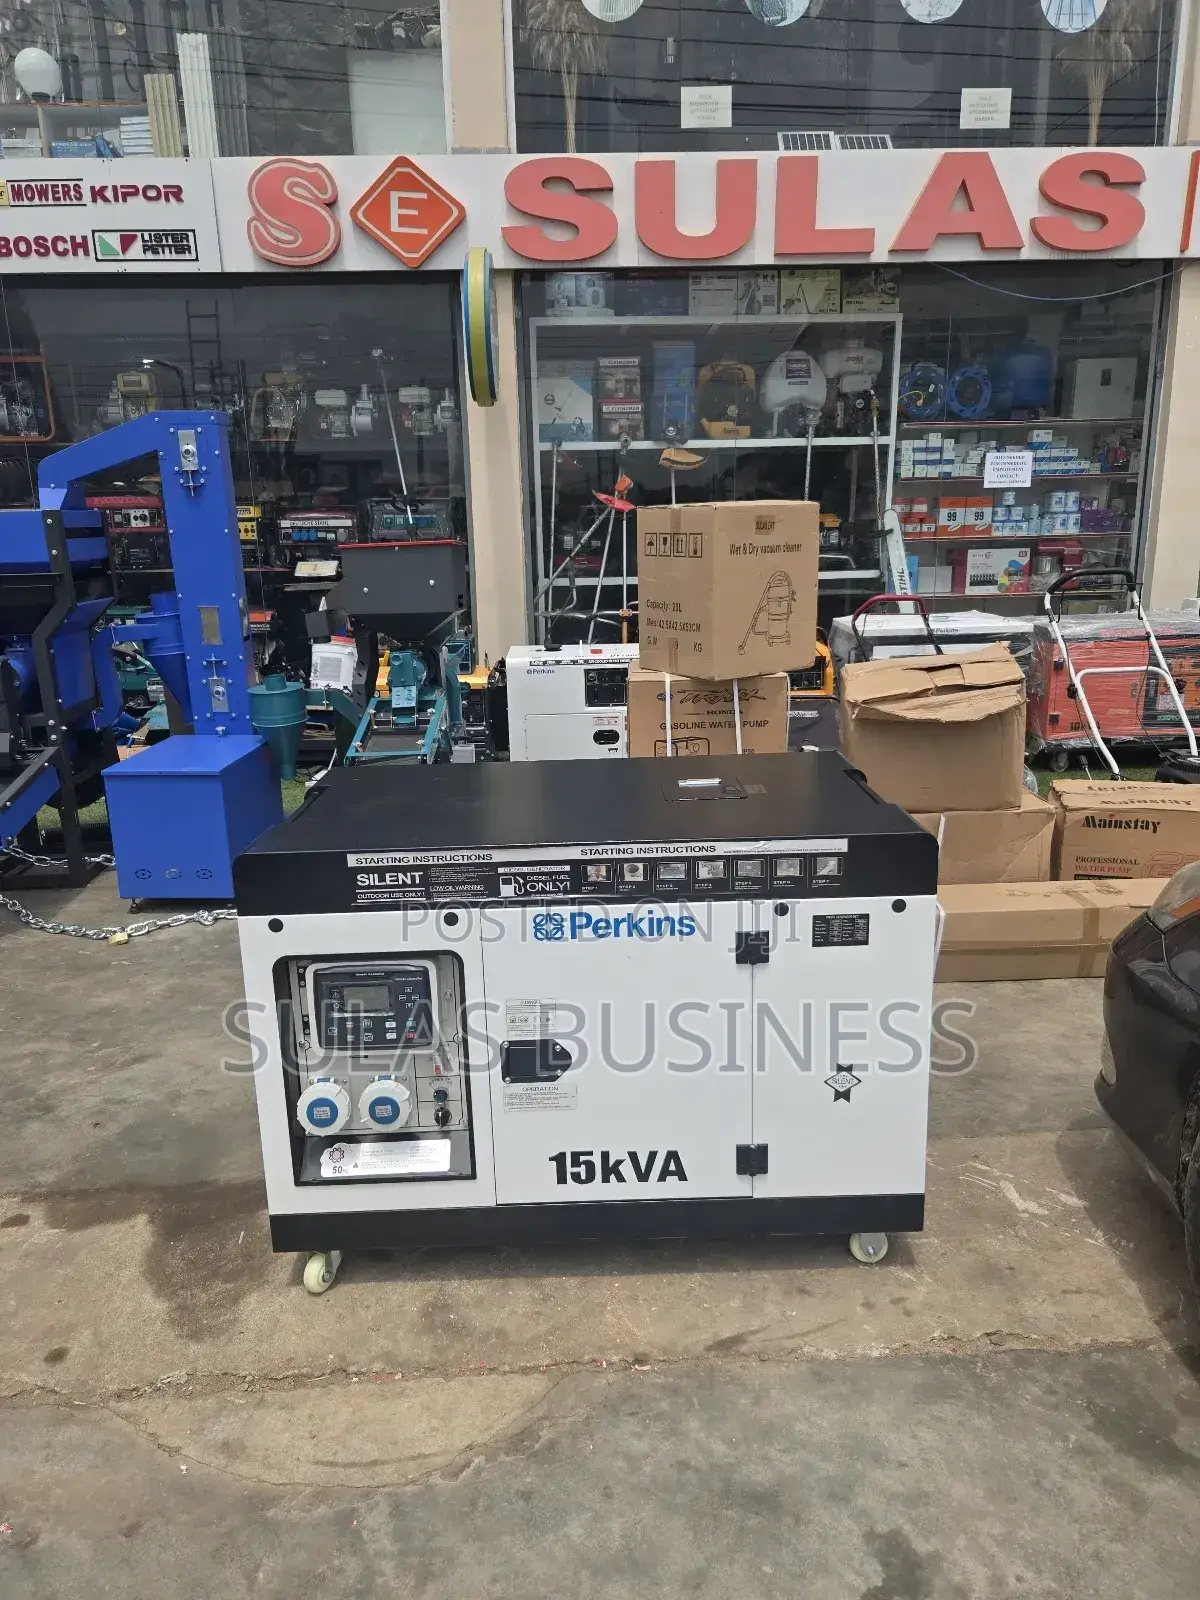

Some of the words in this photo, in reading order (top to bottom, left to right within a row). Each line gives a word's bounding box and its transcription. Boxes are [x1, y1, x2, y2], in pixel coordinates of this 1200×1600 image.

[10, 182, 83, 203] MOWERS
[90, 185, 184, 203] KIPOR
[501, 151, 1147, 262] SULAS
[141, 233, 190, 243] LISTER
[0, 235, 90, 258] BOSCH
[143, 244, 192, 255] PETTER
[946, 511, 957, 522] 99
[974, 510, 985, 521] 99
[730, 544, 742, 555] Wet
[742, 544, 748, 554] &
[750, 543, 760, 558] Dry
[760, 544, 782, 555] vacuum
[783, 543, 802, 554] cleaner
[693, 642, 703, 652] KG
[743, 720, 769, 728] PUMP
[1081, 813, 1161, 834] Mainstay
[580, 847, 634, 856] STARTING
[636, 845, 717, 855] INSTRUCTIONS
[355, 857, 410, 865] STARTING
[412, 853, 494, 864] INSTRUCTIONS
[1075, 855, 1140, 866] PROFESSIONAL
[1074, 865, 1105, 875] WATER
[1107, 866, 1136, 876] PUMP
[356, 872, 424, 887] SILENT
[526, 881, 571, 892] ONLY!
[357, 892, 390, 900] OUTDOOR
[571, 910, 696, 940] Perkins
[832, 1077, 854, 1085] SILENT
[548, 1150, 689, 1185] 15kVA
